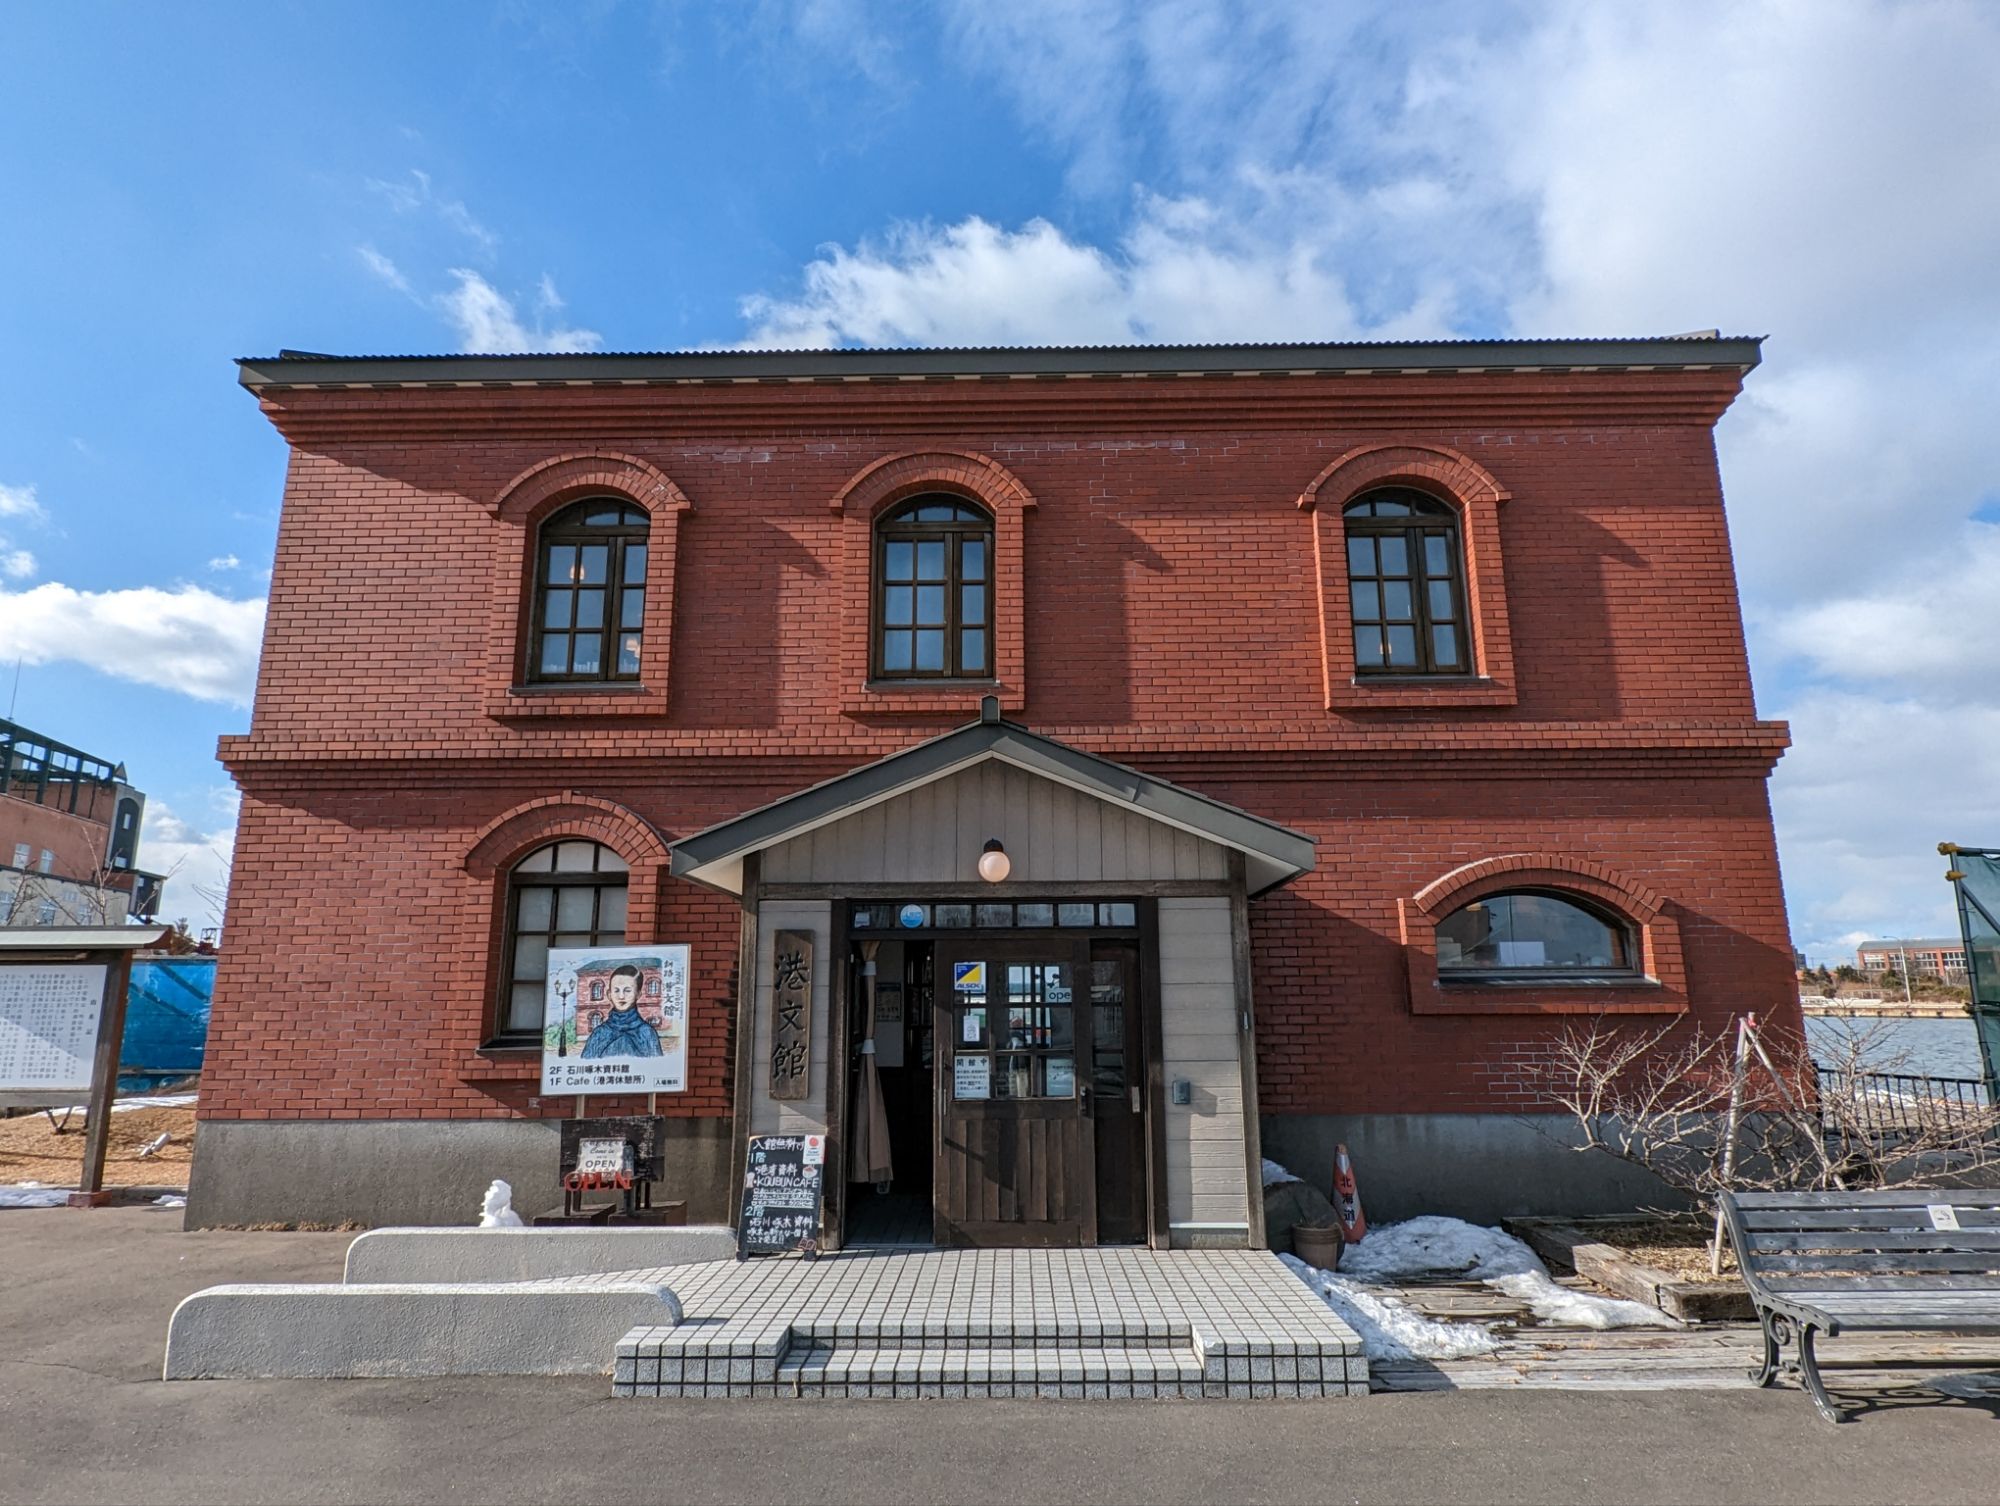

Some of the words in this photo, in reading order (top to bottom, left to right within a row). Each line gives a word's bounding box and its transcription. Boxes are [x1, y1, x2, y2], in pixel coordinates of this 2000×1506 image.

[772, 951, 809, 1081] 港文館
[549, 1065, 562, 1075] 2F
[567, 1064, 630, 1075] 石川啄木資料館
[550, 1077, 562, 1086] 1F
[566, 1076, 590, 1086] Cafe
[585, 1160, 616, 1168] OPEN
[564, 1171, 633, 1192] OPEN
[1341, 1176, 1355, 1221] 北海道
